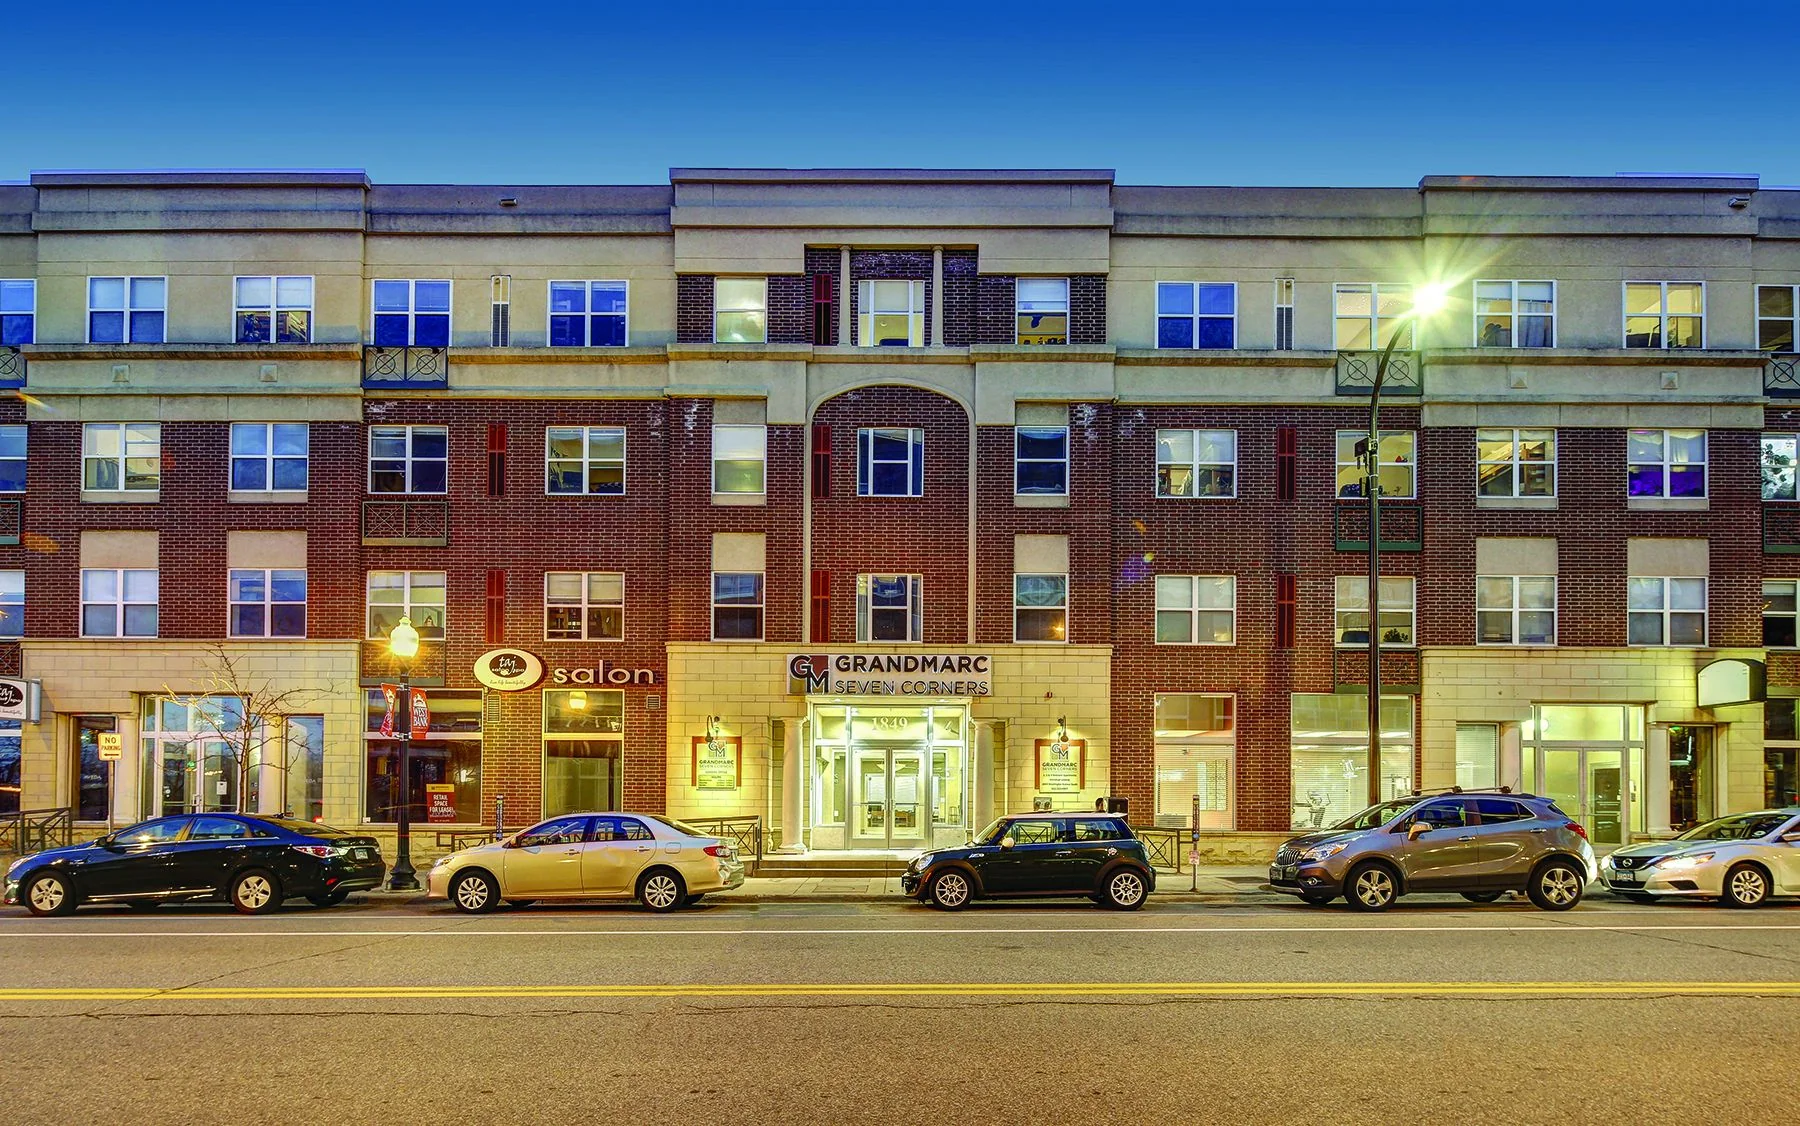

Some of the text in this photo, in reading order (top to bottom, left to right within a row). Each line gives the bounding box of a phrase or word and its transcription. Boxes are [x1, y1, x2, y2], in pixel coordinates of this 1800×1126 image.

[499, 656, 516, 675] taj
[553, 659, 654, 684] salon
[835, 655, 989, 673] GRANDMARC
[835, 680, 989, 695] SEVEN CORNERS
[413, 706, 428, 717] WEST
[413, 716, 428, 726] BANK
[871, 716, 908, 731] 1849
